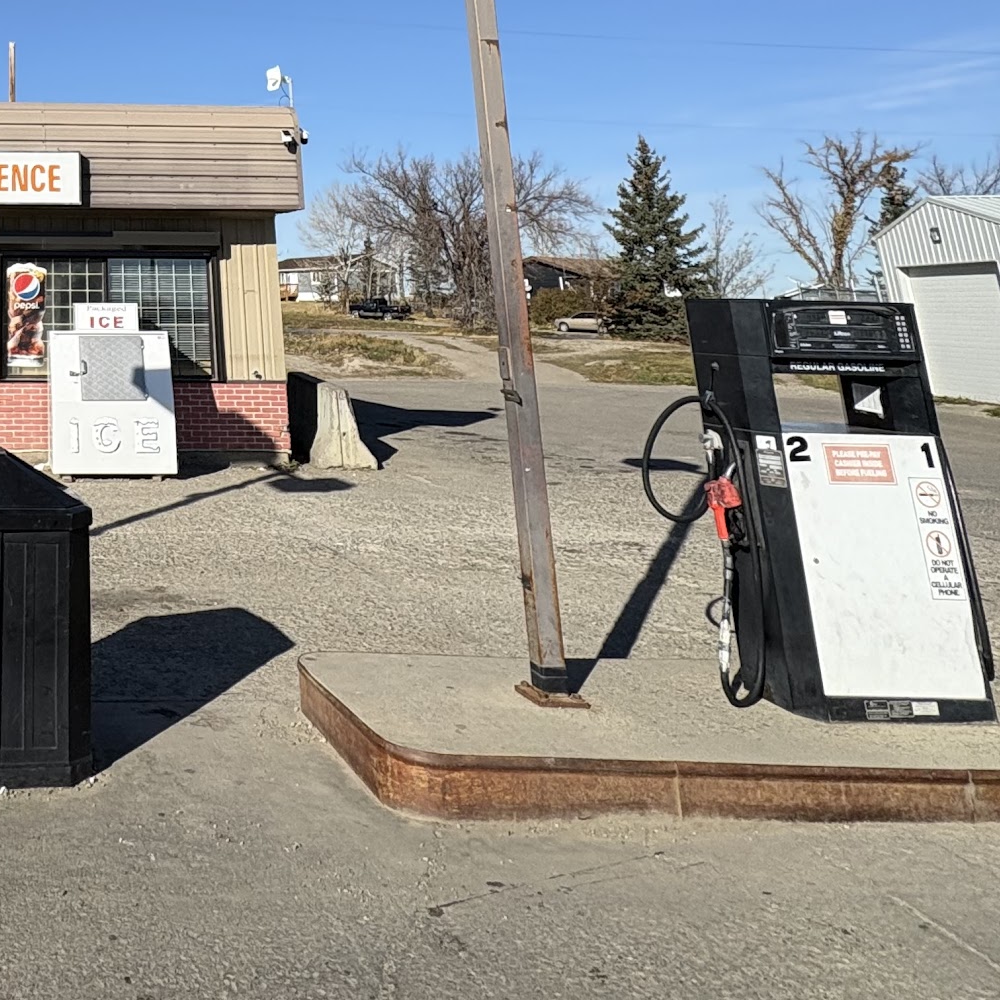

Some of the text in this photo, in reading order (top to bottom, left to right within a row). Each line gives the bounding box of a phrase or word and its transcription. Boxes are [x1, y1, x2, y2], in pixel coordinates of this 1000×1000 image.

[89, 316, 124, 328] ICE
[790, 362, 886, 373] REGULAR GASOLINE
[69, 417, 161, 454] ICE
[786, 436, 811, 462] 2
[832, 450, 856, 458] PLEASE
[920, 442, 935, 468] 1
[835, 468, 860, 477] BEFORE
